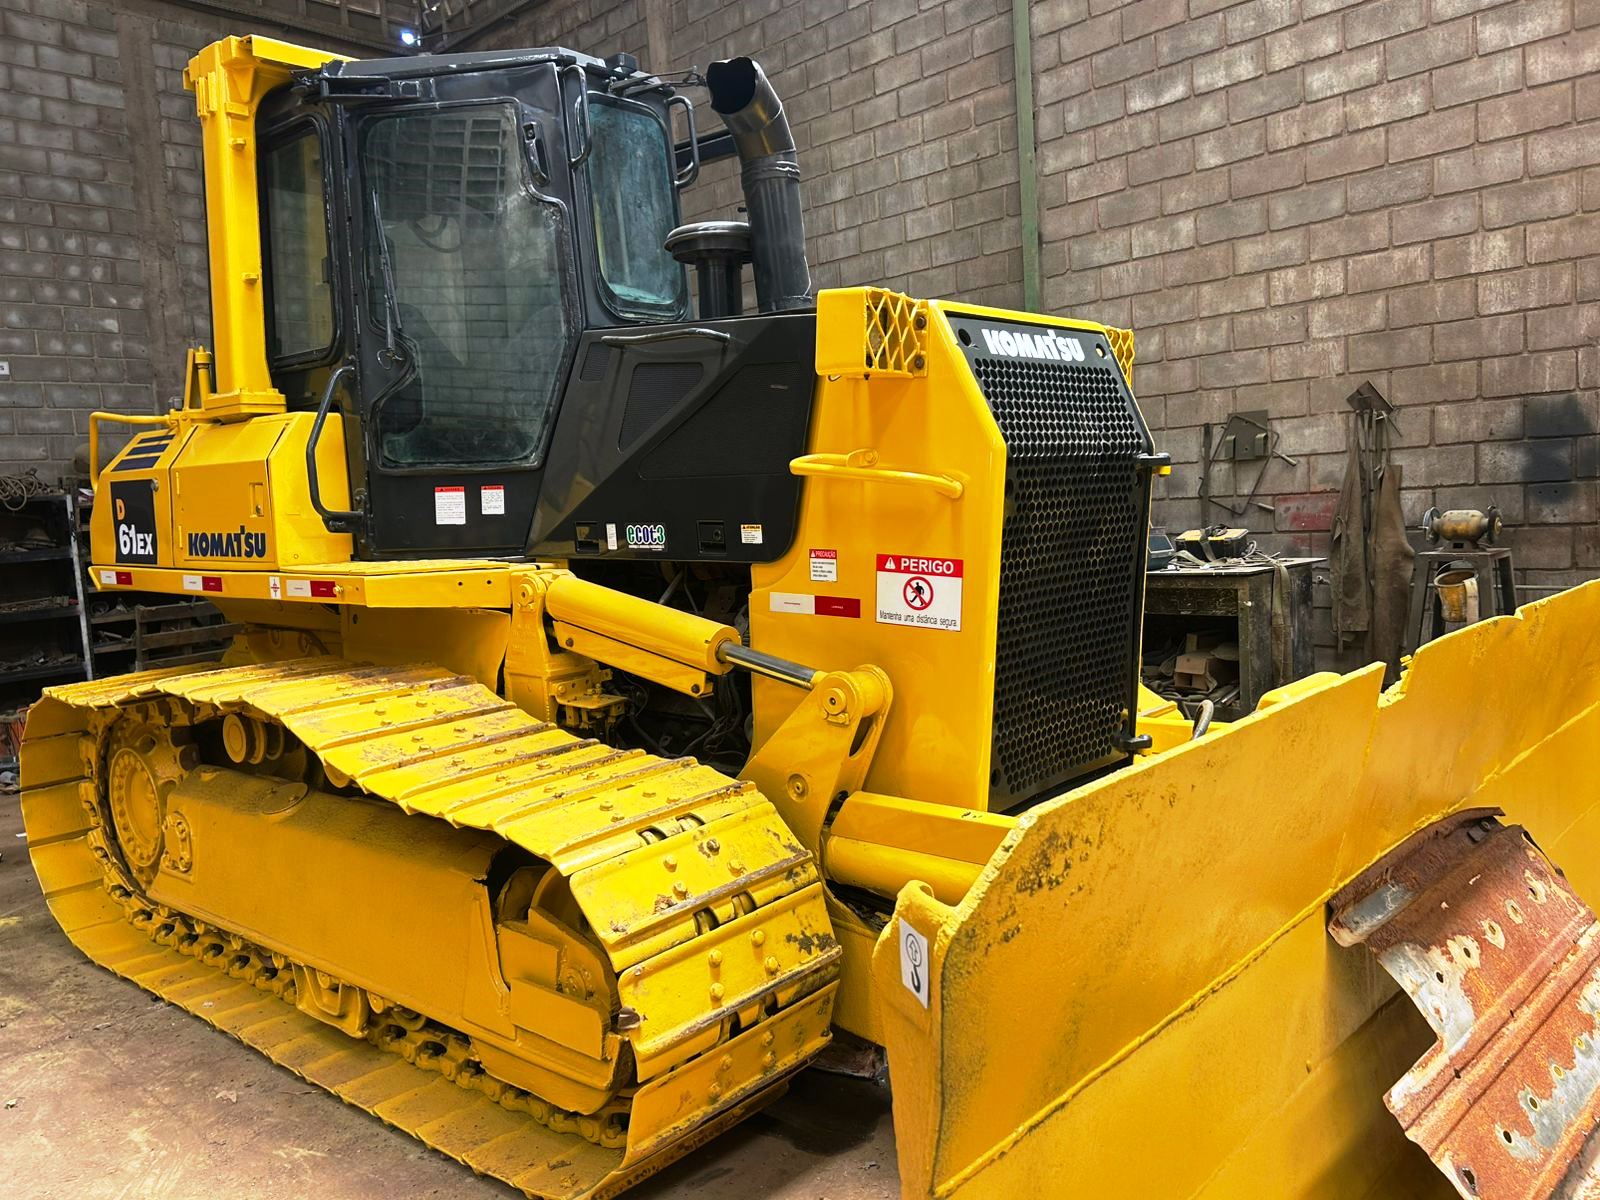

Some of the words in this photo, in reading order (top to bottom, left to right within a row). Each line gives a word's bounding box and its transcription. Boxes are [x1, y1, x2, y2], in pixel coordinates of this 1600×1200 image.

[981, 328, 1085, 362] KOMATSU
[115, 499, 125, 521] D
[119, 523, 153, 556] 61EX
[188, 525, 266, 558] KOMATSU
[626, 524, 666, 545] ecot3
[900, 557, 954, 574] PERIGO
[879, 609, 902, 621] Mantenha
[904, 614, 914, 623] uma
[916, 613, 938, 625] distância
[939, 617, 957, 628] segura
